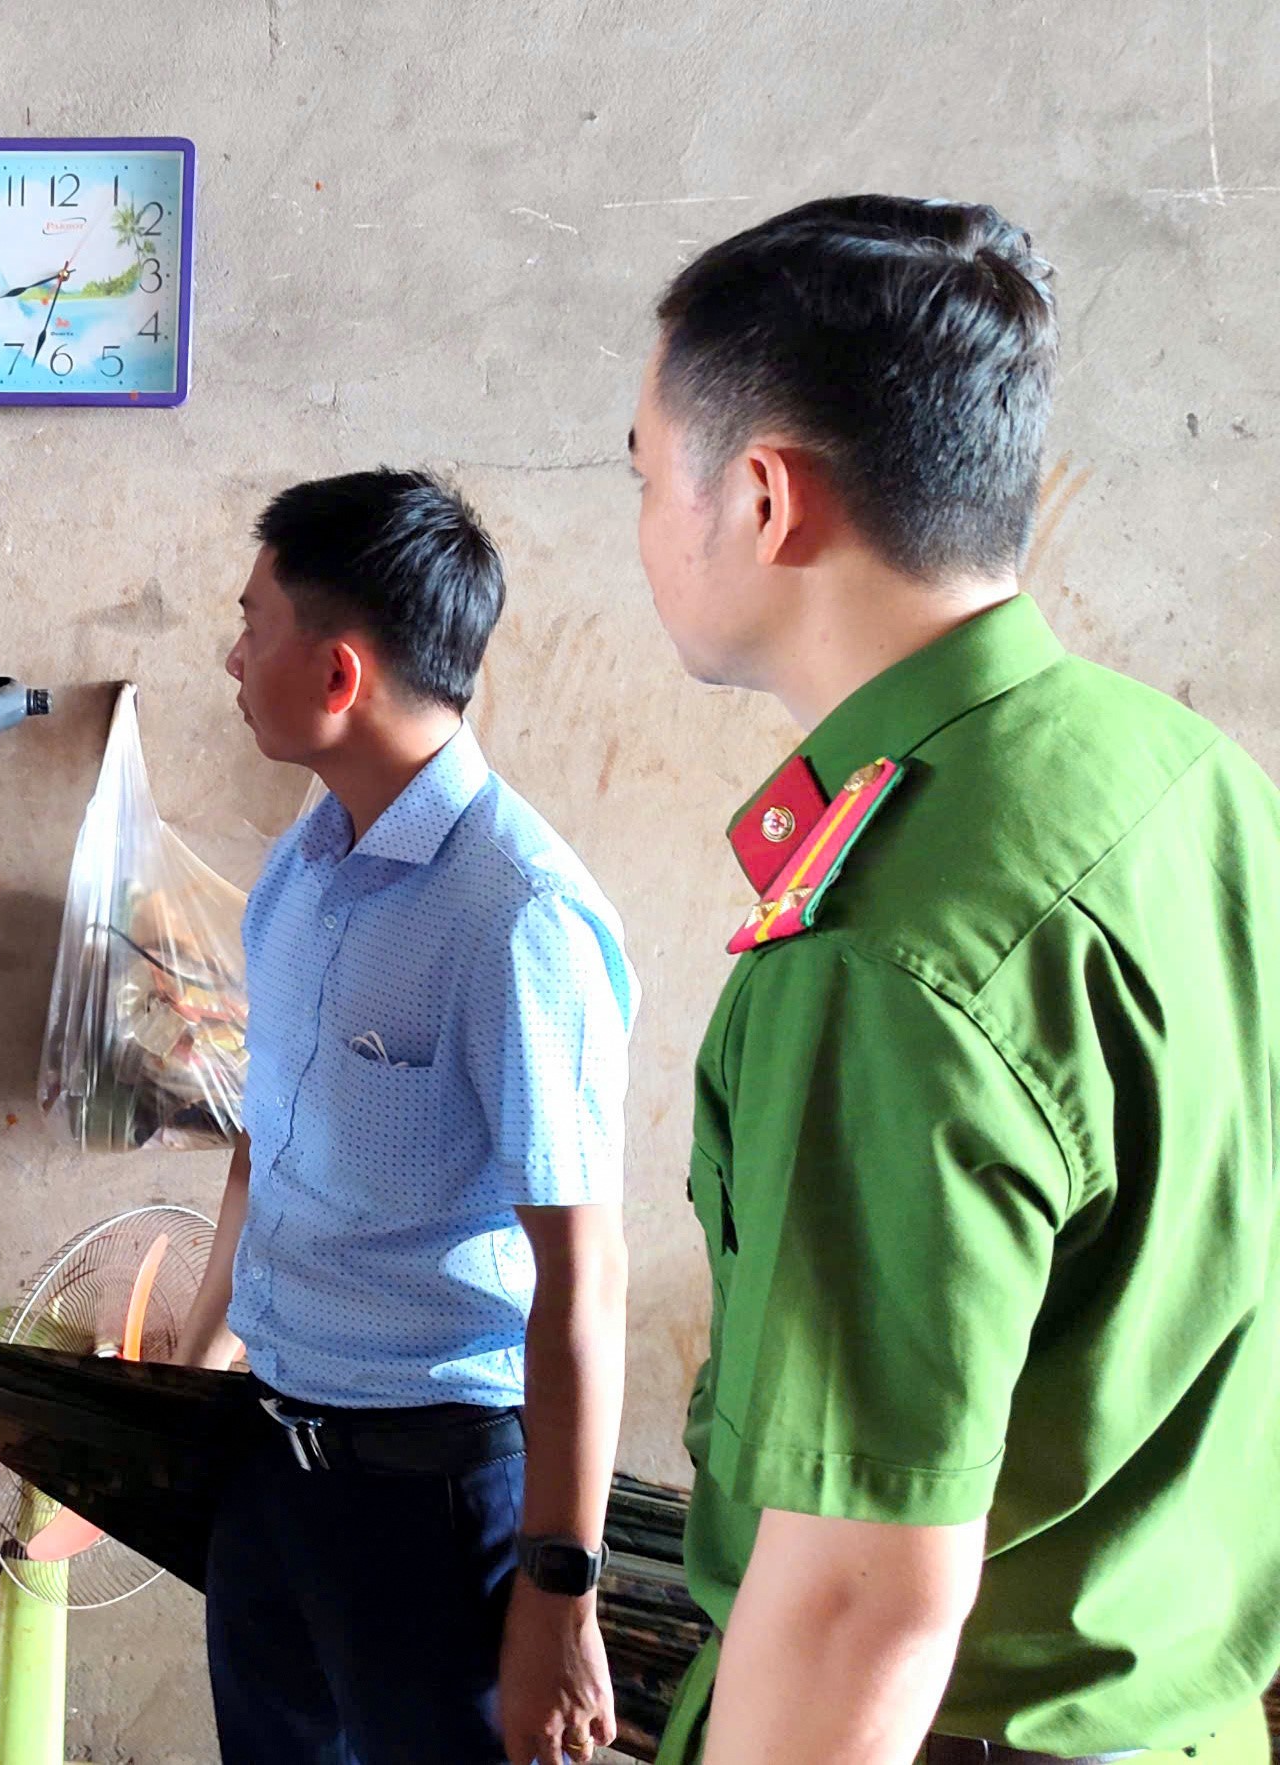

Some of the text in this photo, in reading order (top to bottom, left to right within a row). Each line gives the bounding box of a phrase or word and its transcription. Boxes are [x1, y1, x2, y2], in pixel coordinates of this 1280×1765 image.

[8, 174, 24, 207] 11
[50, 173, 80, 207] 12
[113, 174, 119, 207] 1
[135, 201, 163, 236] 2
[139, 258, 162, 293] 3
[137, 310, 161, 343] 4
[4, 343, 24, 375] 7
[50, 344, 73, 376] 6
[100, 345, 123, 377] 5
